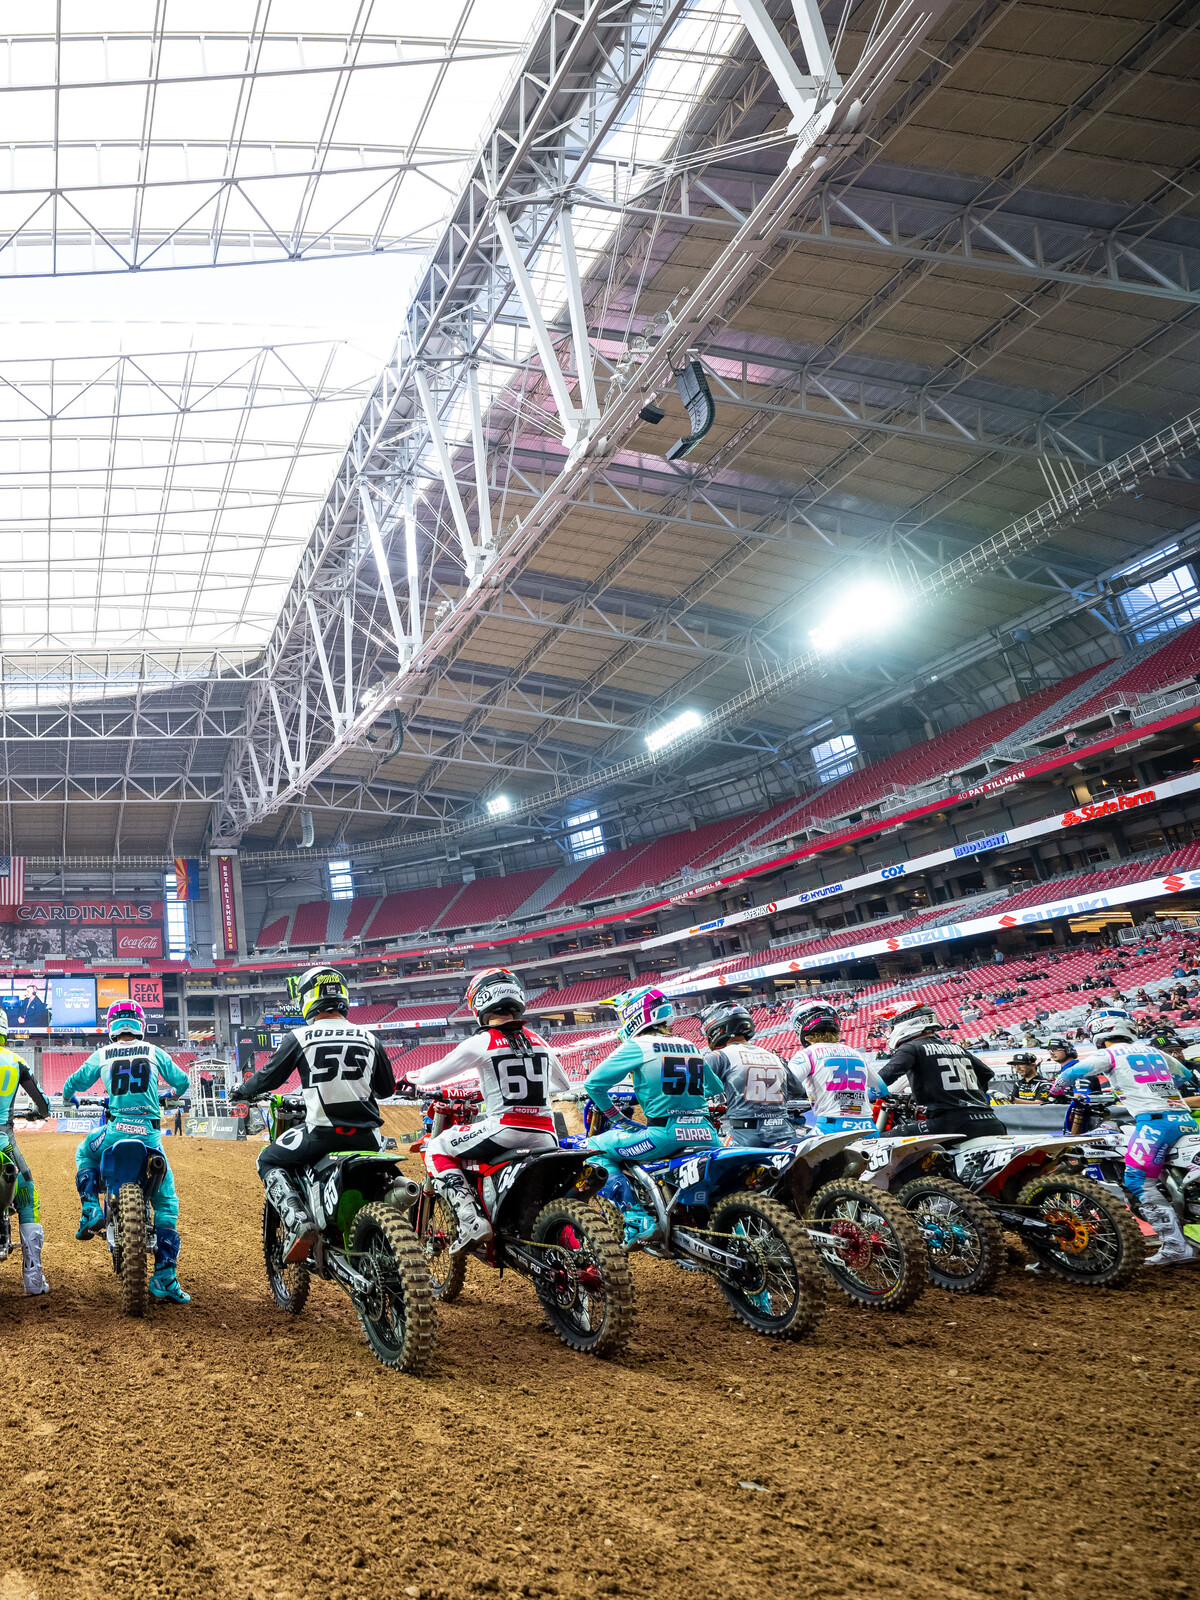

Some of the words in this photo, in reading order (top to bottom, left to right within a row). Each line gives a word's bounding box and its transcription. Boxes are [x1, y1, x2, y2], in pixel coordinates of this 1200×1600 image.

[968, 787, 984, 796] PAT
[986, 771, 1026, 790] TILLMAN
[955, 844, 976, 856] BUD
[975, 834, 1005, 850] LIGHT
[881, 865, 906, 879] COX
[223, 866, 232, 926] ESTABLISHED
[670, 893, 689, 903] CHARLES
[810, 884, 844, 900] HYUNDAI
[17, 904, 153, 920] CARDINALS
[134, 983, 159, 993] SEAT
[134, 993, 161, 1003] GEEK
[623, 996, 647, 1017] LEATT
[304, 1029, 369, 1041] RODBELL
[625, 1013, 644, 1037] LEATT
[105, 1046, 150, 1060] WAGEMAN
[653, 1043, 702, 1054] SURRAT
[312, 1045, 371, 1084] 55
[824, 1058, 867, 1091] 35
[937, 1057, 979, 1091] 216
[1126, 1053, 1172, 1084] 98
[111, 1058, 151, 1096] 69
[498, 1057, 548, 1100] 64
[661, 1056, 704, 1096] 58
[744, 1066, 785, 1103] 62
[68, 1120, 91, 1131] WPS
[676, 1116, 704, 1124] LEATT
[842, 1120, 873, 1130] FXR
[1166, 1113, 1193, 1122] FXR
[675, 1127, 712, 1141] SURRY
[626, 1140, 653, 1157] YAMAHA
[1128, 1124, 1162, 1166] FXR
[869, 1149, 889, 1170] 35
[982, 1151, 1012, 1173] 216
[679, 1158, 700, 1190] 58
[812, 1234, 828, 1244] DID
